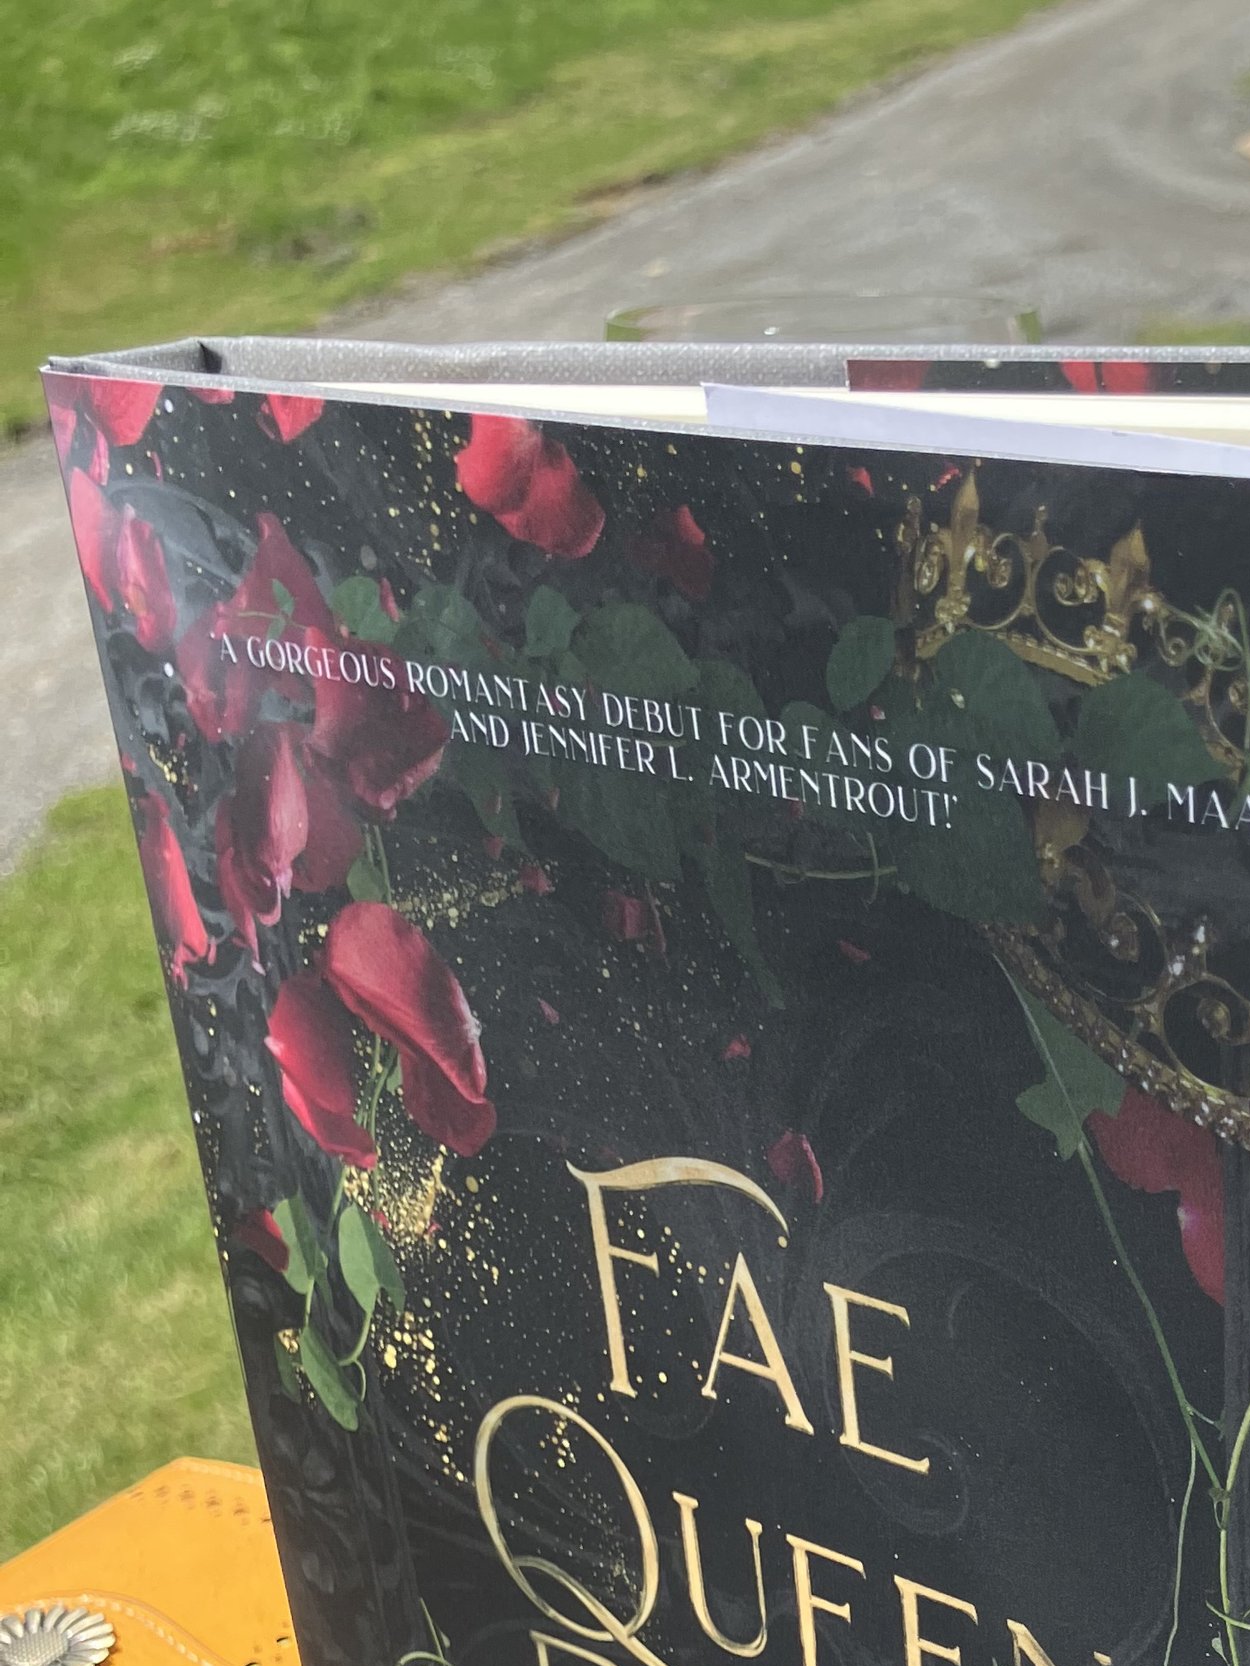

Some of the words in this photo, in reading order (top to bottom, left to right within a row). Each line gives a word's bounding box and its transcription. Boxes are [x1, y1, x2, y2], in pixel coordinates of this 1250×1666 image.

[247, 636, 396, 690] GORGEOUS
[405, 660, 587, 721] ROMANTASY
[602, 691, 701, 741] DEBUT
[718, 711, 788, 756] FOR
[801, 724, 893, 773] FANS
[909, 743, 957, 783] OF
[976, 753, 1109, 810] SARAH
[1128, 776, 1147, 818] J.
[450, 710, 510, 750] AND
[522, 720, 656, 775] JENNIFER
[668, 745, 694, 782] L.
[565, 1156, 930, 1475] FAE
